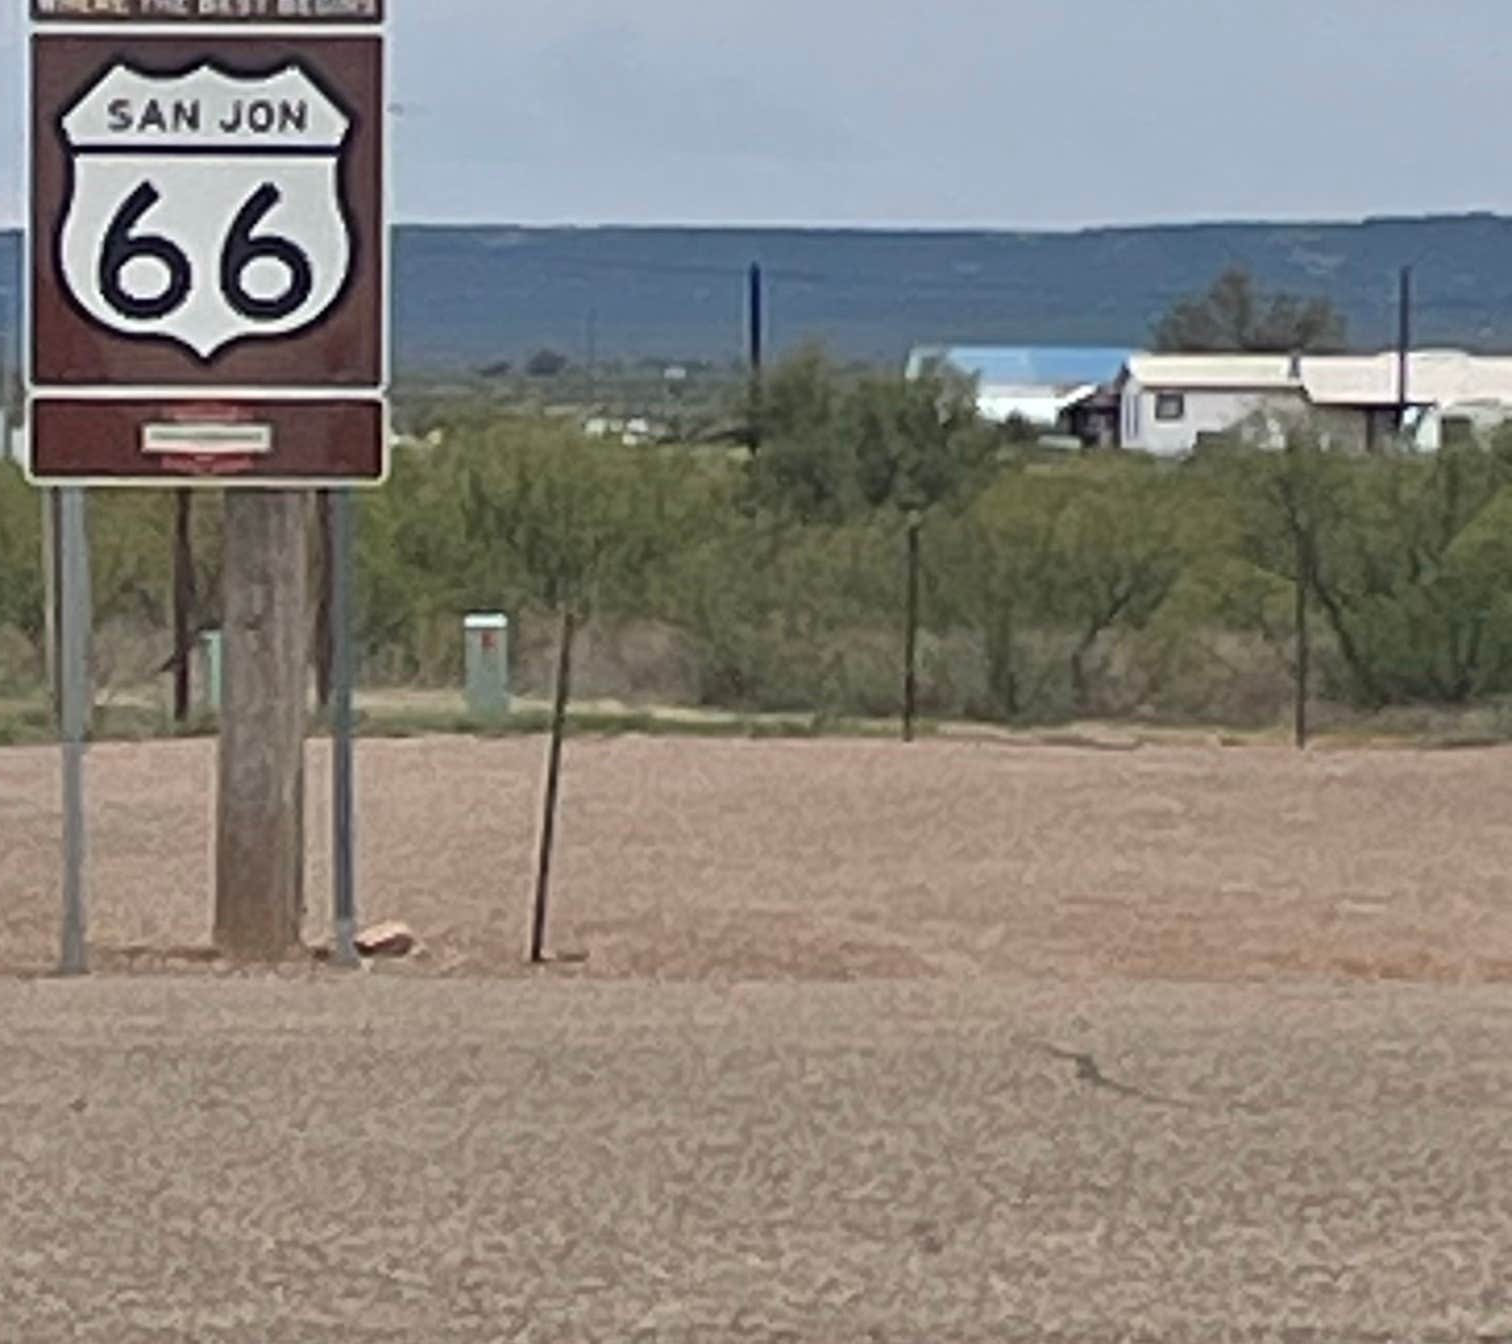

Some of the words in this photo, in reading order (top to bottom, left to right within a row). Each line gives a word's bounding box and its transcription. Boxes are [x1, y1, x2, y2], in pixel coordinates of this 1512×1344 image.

[107, 98, 201, 133] SAN
[219, 98, 308, 134] JON
[99, 179, 313, 323] 66
